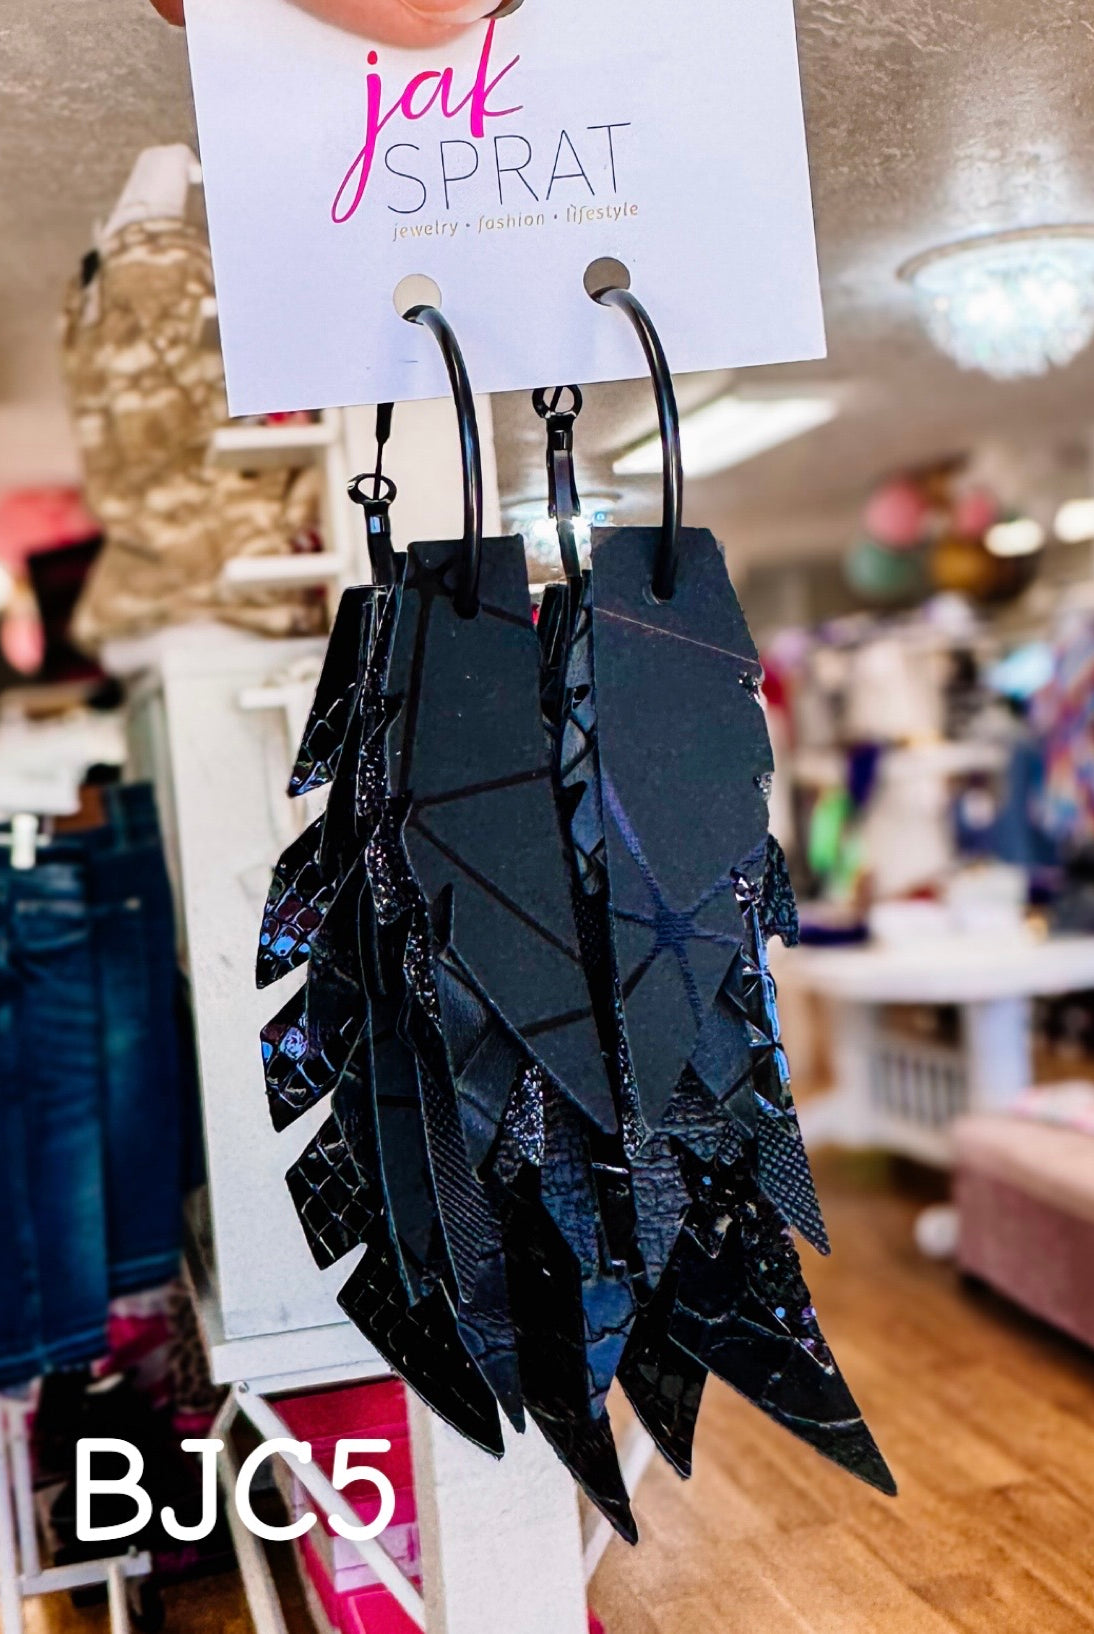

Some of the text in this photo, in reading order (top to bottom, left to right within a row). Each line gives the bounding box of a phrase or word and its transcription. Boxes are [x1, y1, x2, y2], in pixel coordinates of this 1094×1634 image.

[331, 17, 523, 223] jak
[384, 122, 631, 214] SPRAT
[392, 202, 639, 242] jewelry fashion lifestyle
